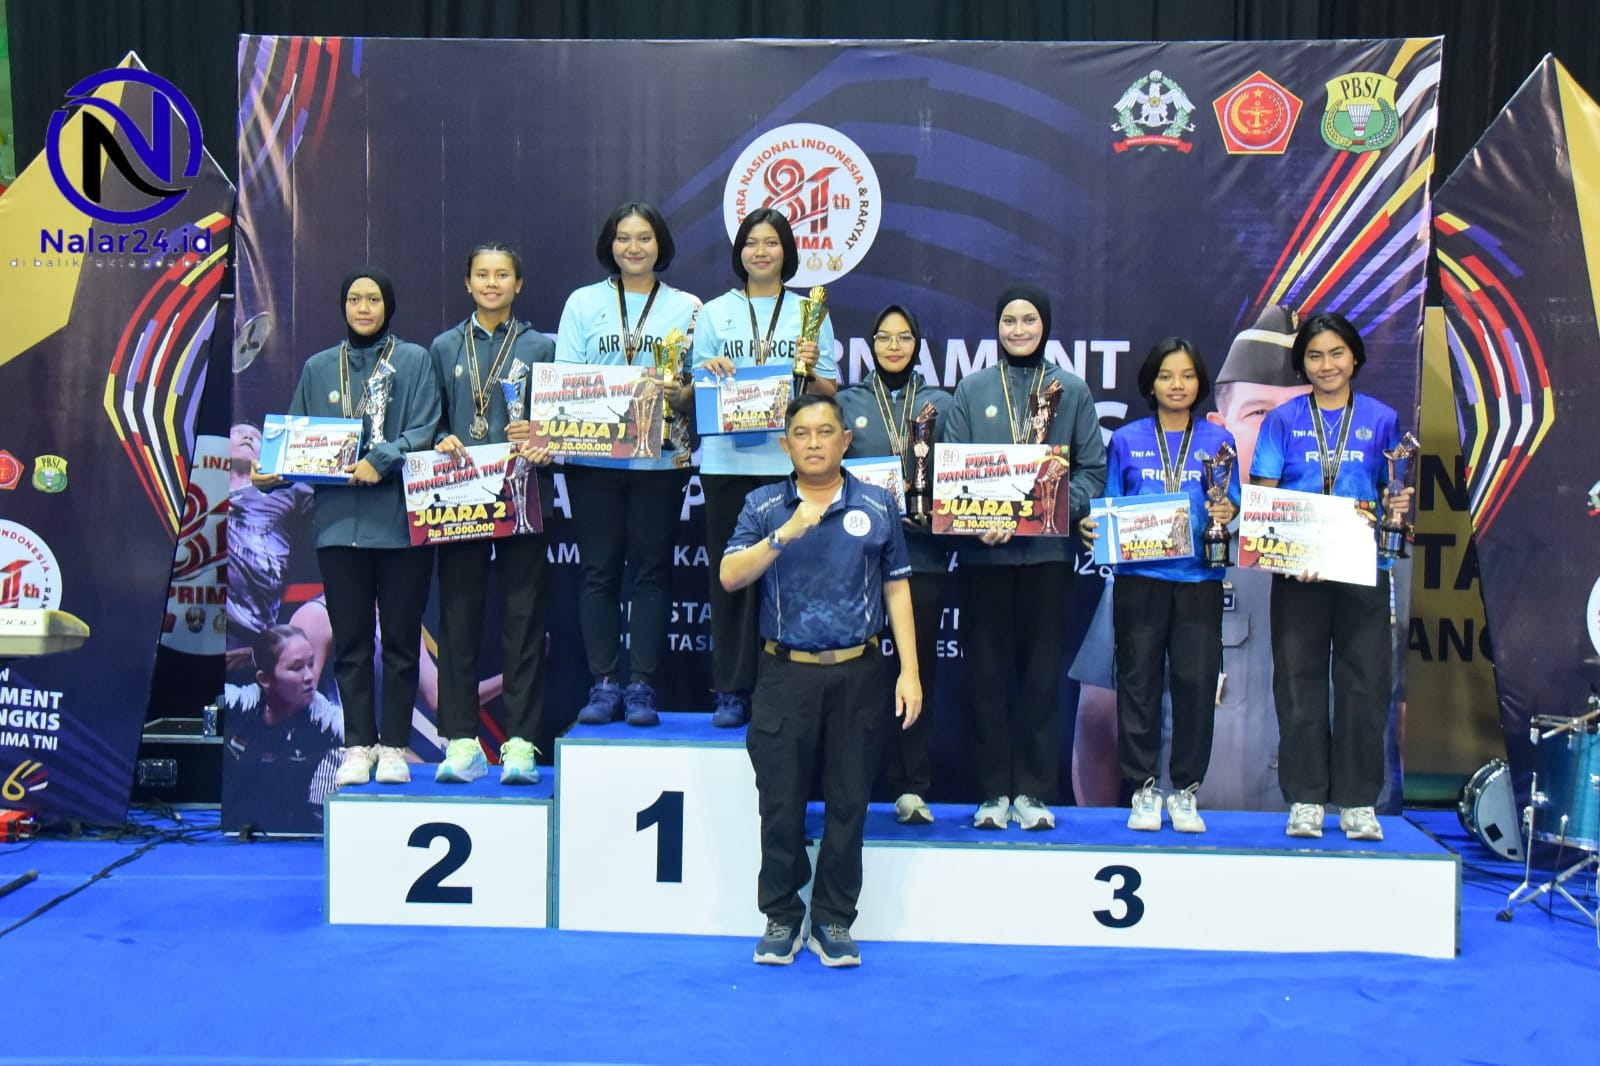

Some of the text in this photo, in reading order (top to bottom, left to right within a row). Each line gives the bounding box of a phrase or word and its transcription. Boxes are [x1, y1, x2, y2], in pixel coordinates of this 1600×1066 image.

[1340, 77, 1381, 100] PBSI
[741, 139, 799, 186] NASIONAL
[801, 138, 864, 186] INDONESIA
[844, 200, 869, 250] RAKYAT
[599, 335, 620, 355] AIR
[723, 340, 796, 359] AIR FRCE
[536, 420, 627, 439] JUARA 1
[965, 454, 1008, 469] PIALA
[408, 467, 481, 496] PANGLIMA
[937, 464, 1012, 484] PANGLIMA
[413, 501, 507, 527] JUARA 2
[936, 499, 1034, 517] JUARA 3
[33, 734, 58, 751] TNI
[636, 790, 685, 884] 1
[406, 822, 473, 904] 2
[1092, 864, 1145, 928] 3
